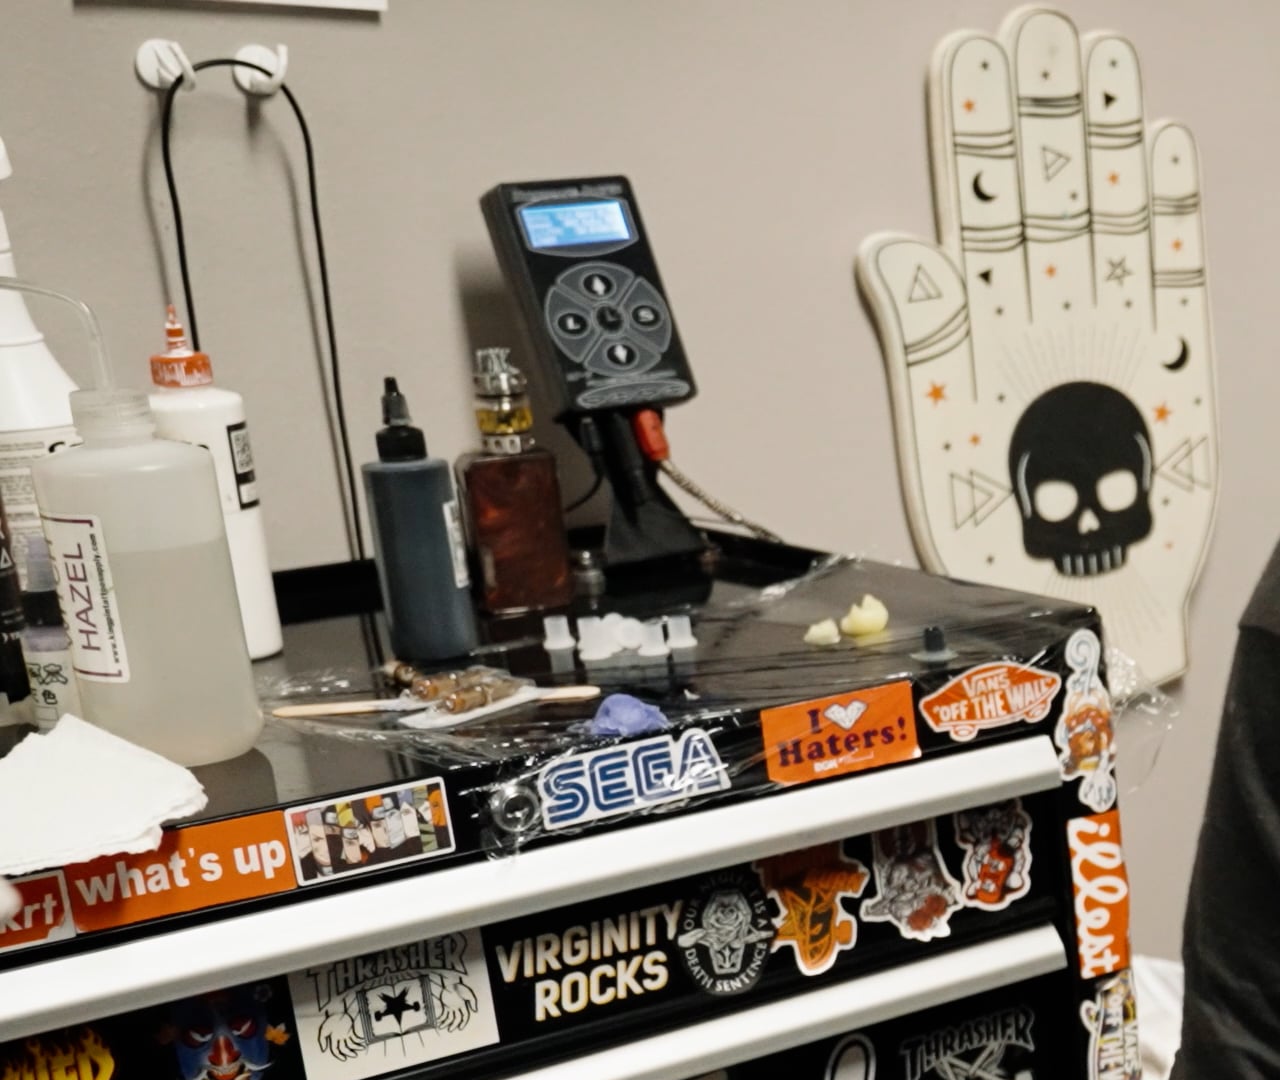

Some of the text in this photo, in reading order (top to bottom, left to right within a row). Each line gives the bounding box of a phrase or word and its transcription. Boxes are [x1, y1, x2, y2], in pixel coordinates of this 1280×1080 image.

[62, 542, 101, 651] HAZEL
[962, 667, 1011, 697] VANS
[971, 693, 1006, 721] THE
[778, 716, 908, 768] Haters!
[806, 708, 822, 734] I
[543, 737, 722, 824] SEGA
[76, 836, 287, 907] what's up
[1067, 818, 1128, 979] illest
[306, 931, 468, 1012] THRASHER
[497, 900, 685, 984] VIRGINITY
[685, 941, 768, 992] DEATH SENTENCE
[535, 950, 670, 1022] ROCKS
